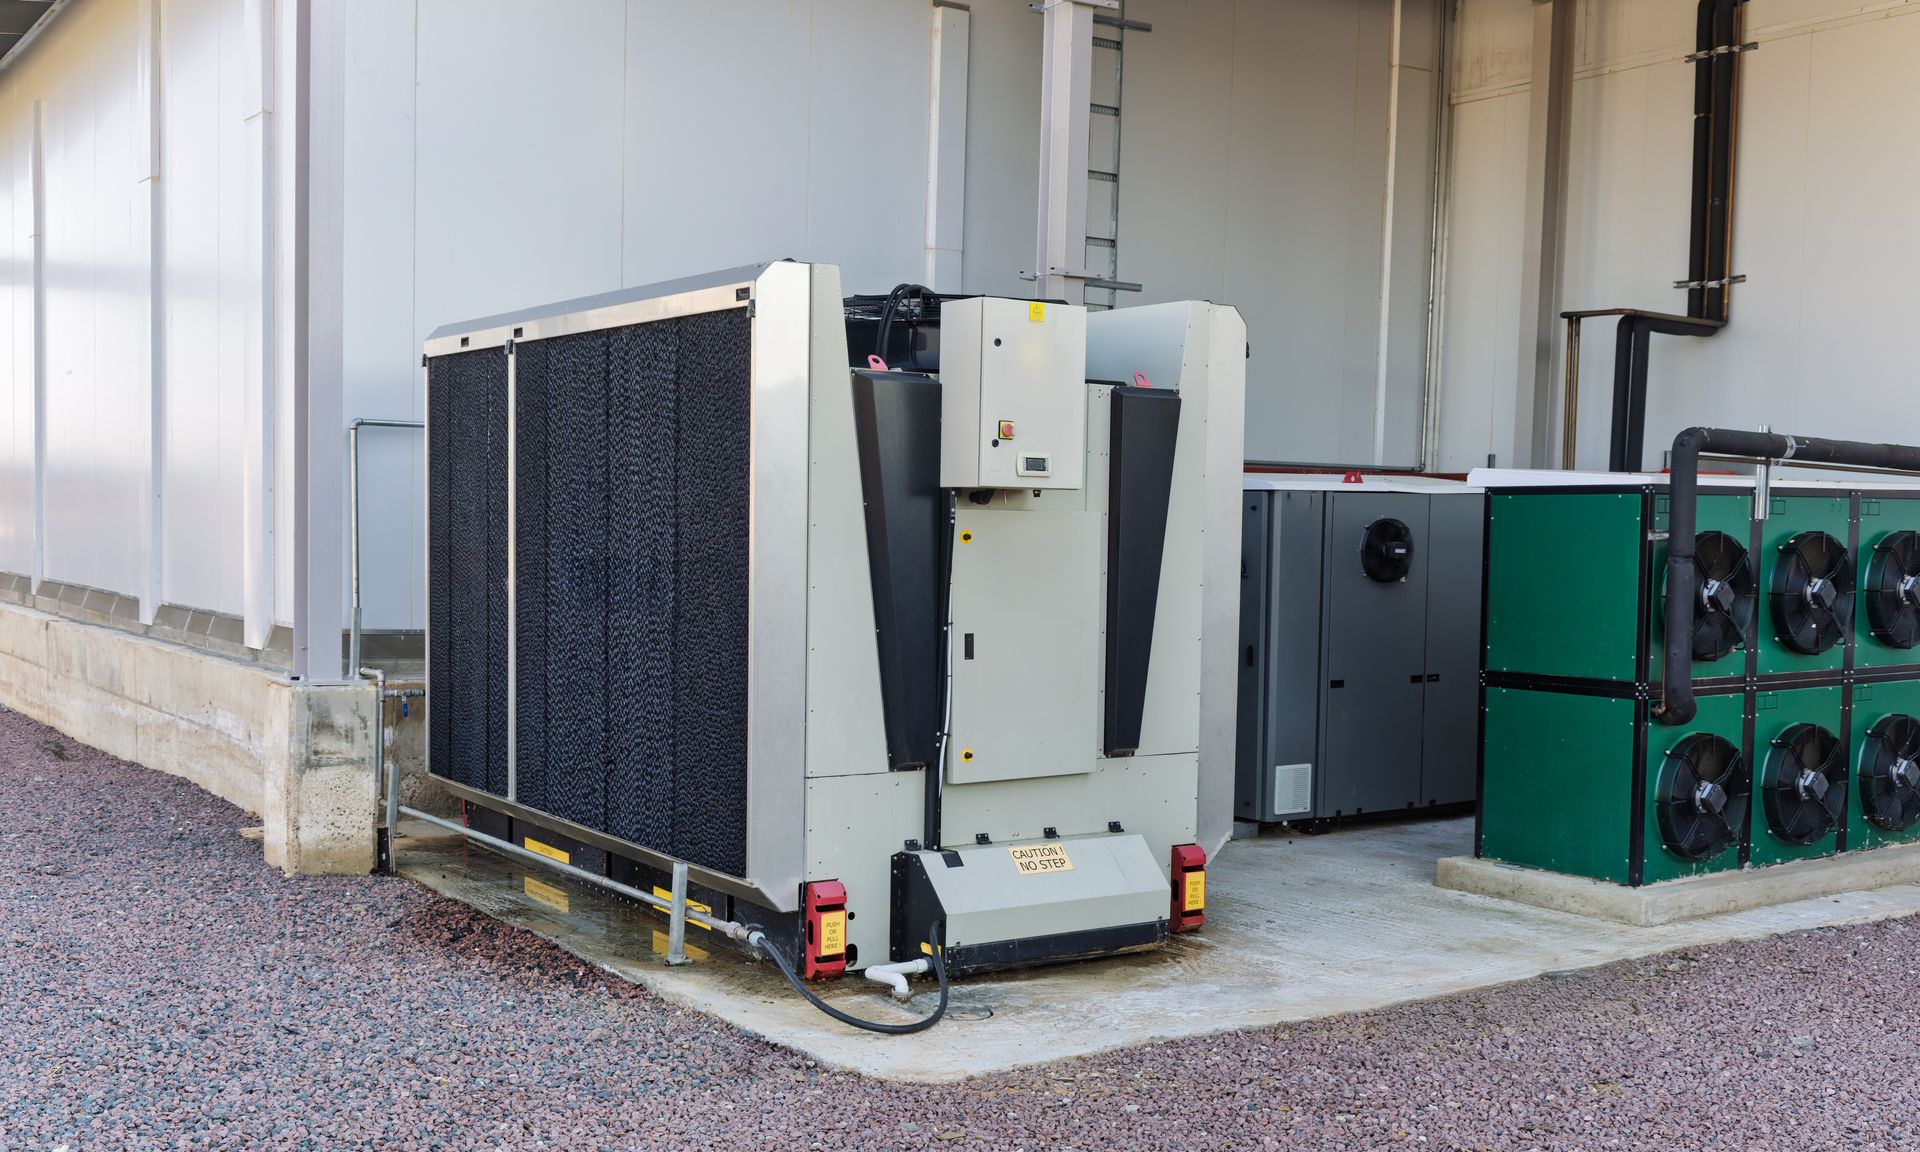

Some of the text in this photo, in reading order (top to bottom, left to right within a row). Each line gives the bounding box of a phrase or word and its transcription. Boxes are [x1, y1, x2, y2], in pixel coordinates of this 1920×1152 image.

[1012, 846, 1058, 860] CAUTION
[1019, 857, 1066, 872] NO STEP
[826, 935, 839, 943] PULL
